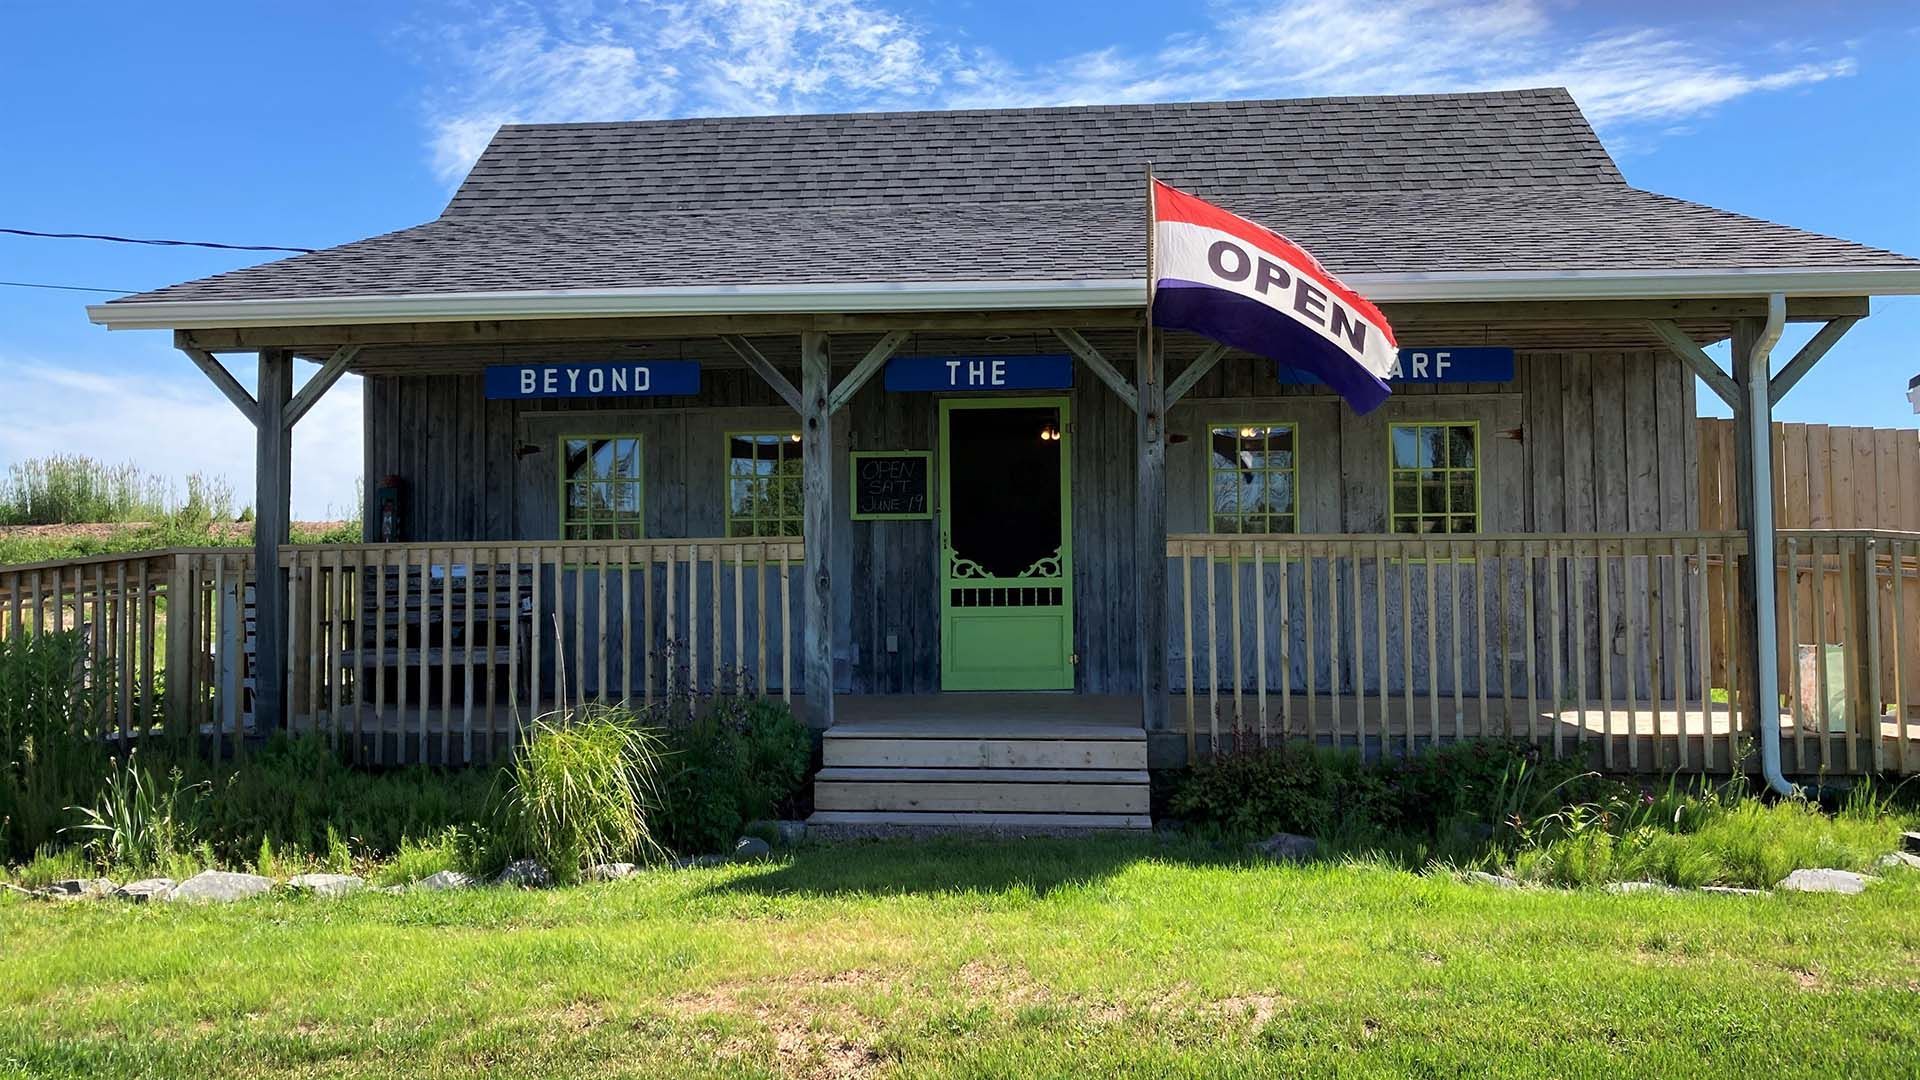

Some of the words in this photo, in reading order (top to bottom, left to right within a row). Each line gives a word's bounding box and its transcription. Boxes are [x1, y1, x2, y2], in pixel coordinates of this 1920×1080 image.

[1207, 240, 1367, 354] OPEN
[945, 360, 1006, 386] THE
[1391, 352, 1451, 378] ARF
[520, 366, 651, 394] BEYOND
[863, 460, 915, 480] OPEN
[869, 480, 912, 495] SAT
[863, 496, 899, 512] JUNE
[908, 494, 923, 512] 19
